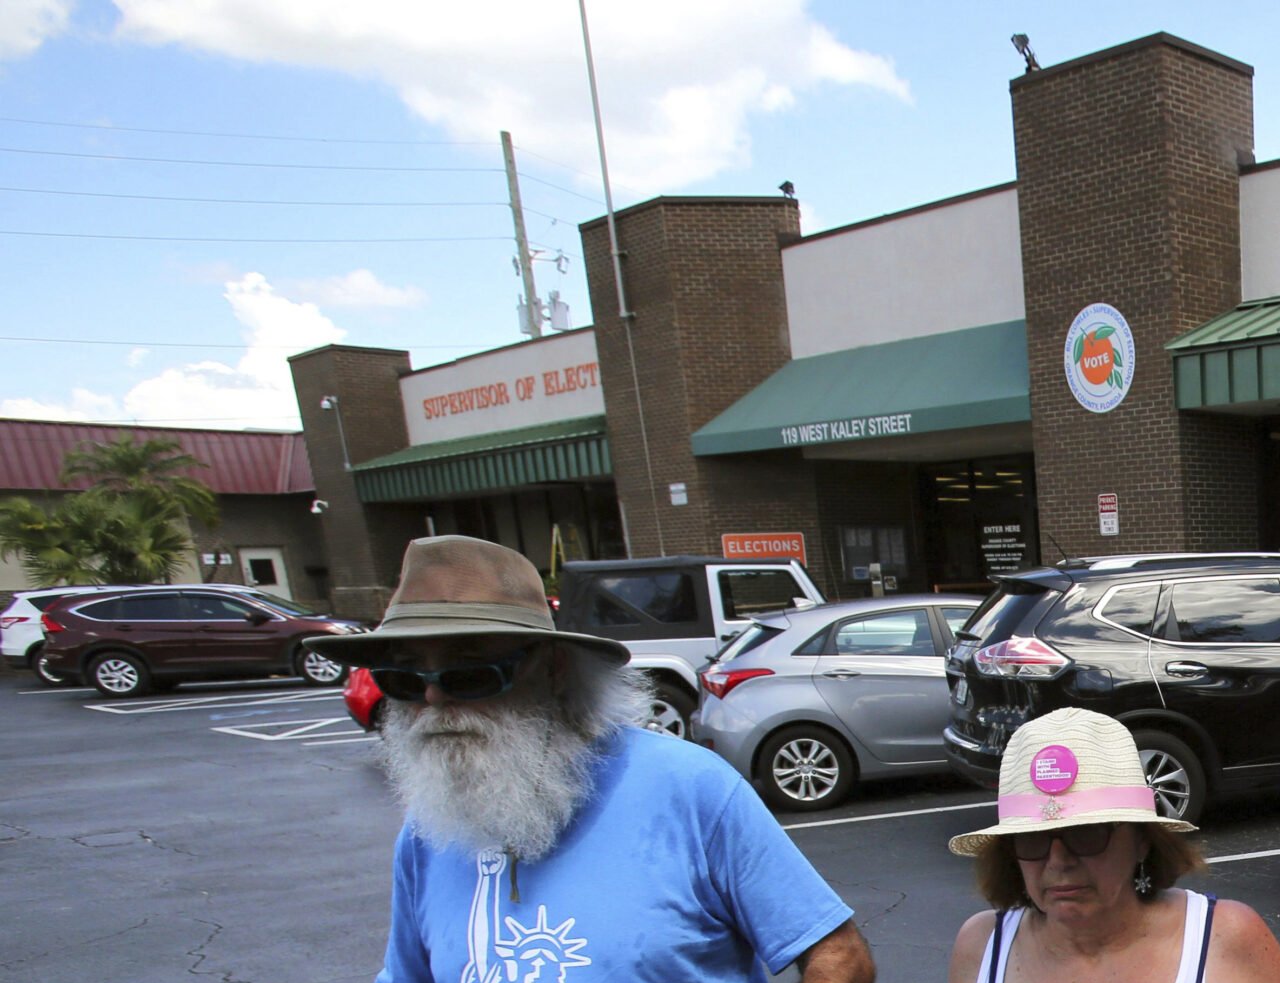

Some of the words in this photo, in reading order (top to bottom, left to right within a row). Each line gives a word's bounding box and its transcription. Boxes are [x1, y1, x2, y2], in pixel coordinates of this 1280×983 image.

[1084, 352, 1110, 369] VOTE
[423, 382, 510, 420] SUPERVISOR
[515, 375, 535, 402] OF
[542, 362, 598, 397] ELECT
[781, 427, 798, 444] 119
[799, 423, 829, 443] WEST
[830, 419, 866, 440] KALEY
[868, 414, 912, 436] STREET
[728, 540, 800, 553] ELECTIONS
